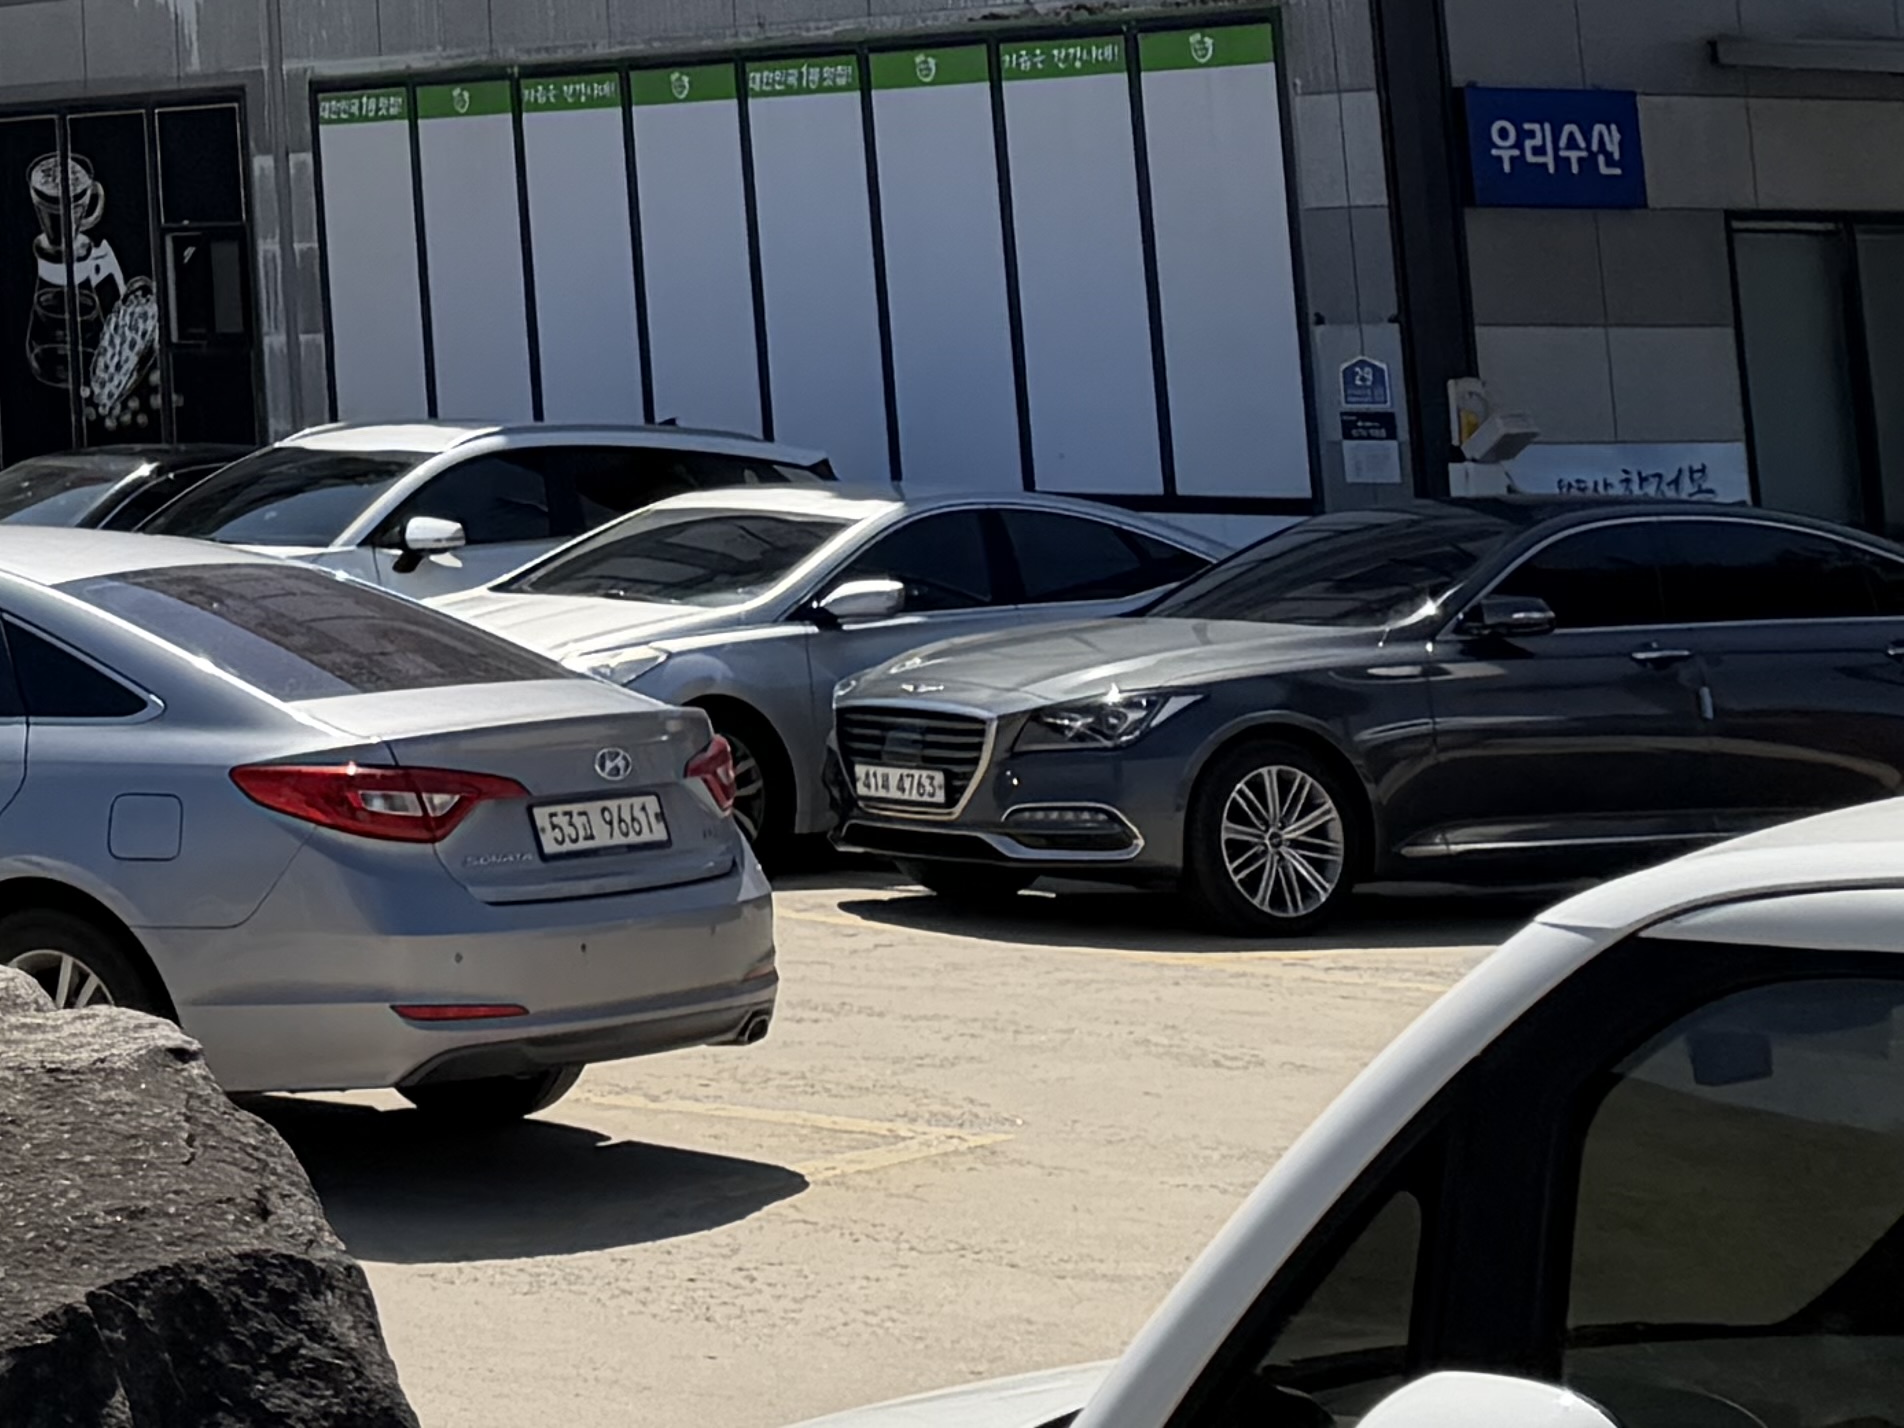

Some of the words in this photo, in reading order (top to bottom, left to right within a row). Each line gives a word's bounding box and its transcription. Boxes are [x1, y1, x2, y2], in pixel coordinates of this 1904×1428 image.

[1490, 119, 1623, 176] 우리수산
[896, 772, 937, 798] 4763
[548, 810, 595, 846] 53고
[600, 802, 654, 840] 9661
